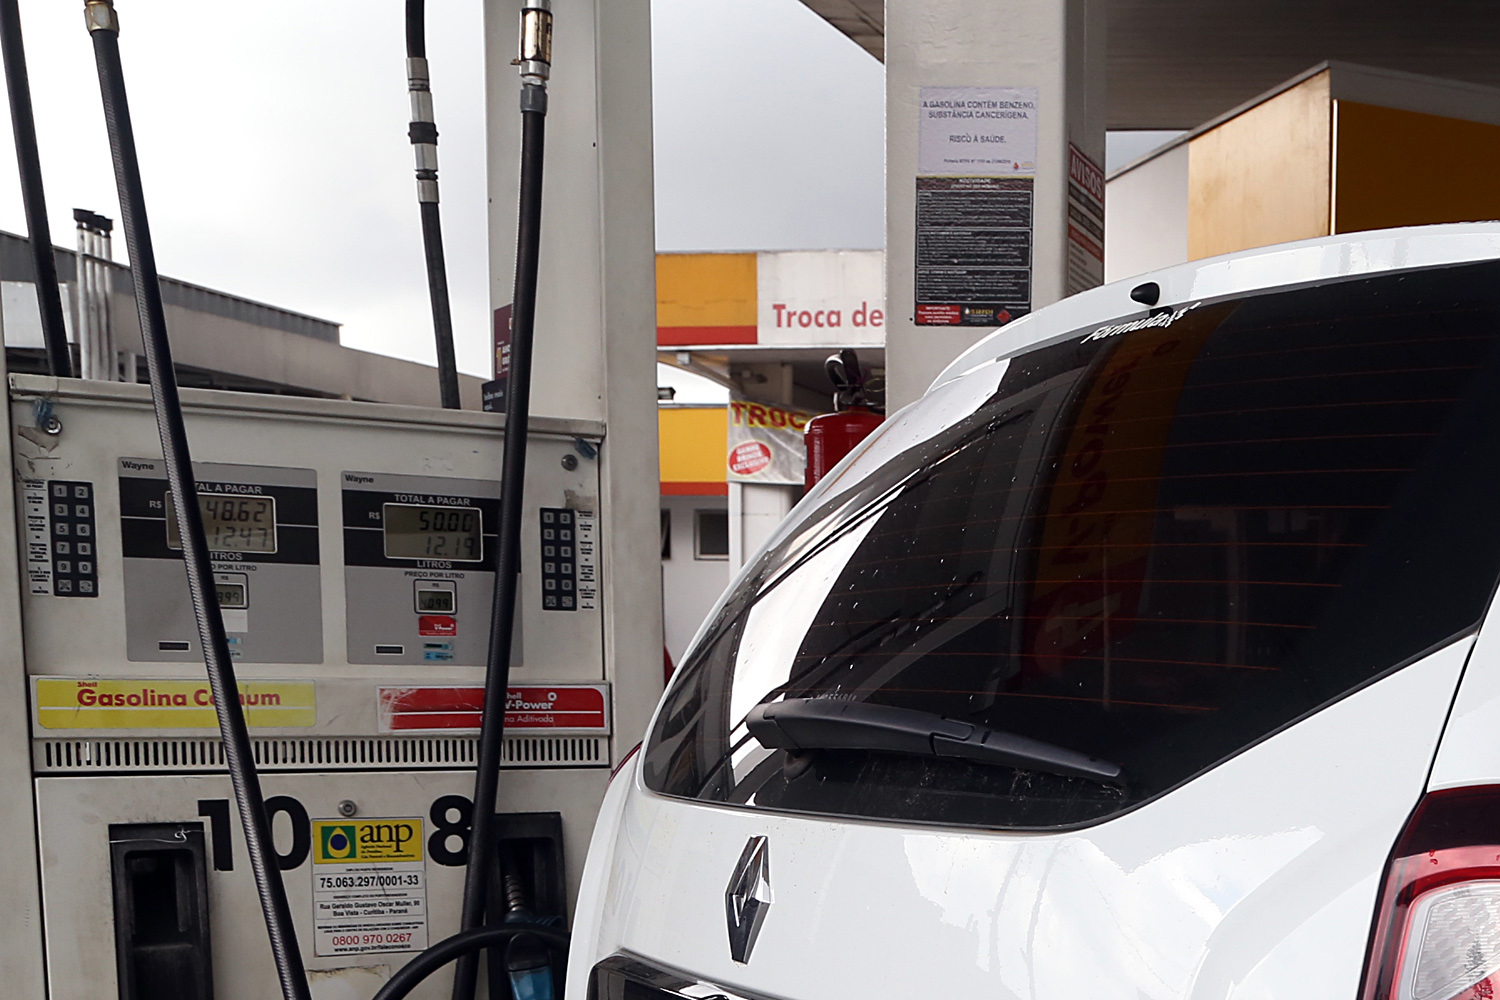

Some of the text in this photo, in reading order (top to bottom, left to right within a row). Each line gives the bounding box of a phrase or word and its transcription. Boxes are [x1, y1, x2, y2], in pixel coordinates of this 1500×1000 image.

[967, 100, 998, 108] CONTÉM
[929, 110, 974, 119] SUBSTÂNCIA
[1071, 155, 1103, 199] AVISOS
[772, 301, 884, 328] Troca de
[731, 402, 811, 430] TROC
[122, 460, 155, 470] Wayne
[344, 474, 374, 483] Wayne
[195, 482, 262, 495] TAL A PAGAR
[149, 500, 162, 509] R$
[394, 494, 471, 506] TOTAL A PAGAR
[206, 500, 267, 522] 48.62
[369, 511, 380, 520] R$
[419, 511, 474, 533] 50.00
[210, 551, 243, 561] ITROS
[417, 560, 452, 569] LITROS
[76, 688, 281, 707] Gasolina Cum
[505, 700, 553, 710] V-Power
[516, 714, 554, 723] Aditivada
[198, 795, 311, 872] 10
[360, 823, 413, 852] anp
[428, 795, 475, 867] 8
[320, 875, 419, 888] 75.063.297/0001-33
[332, 933, 412, 946] 0800 970 0267
